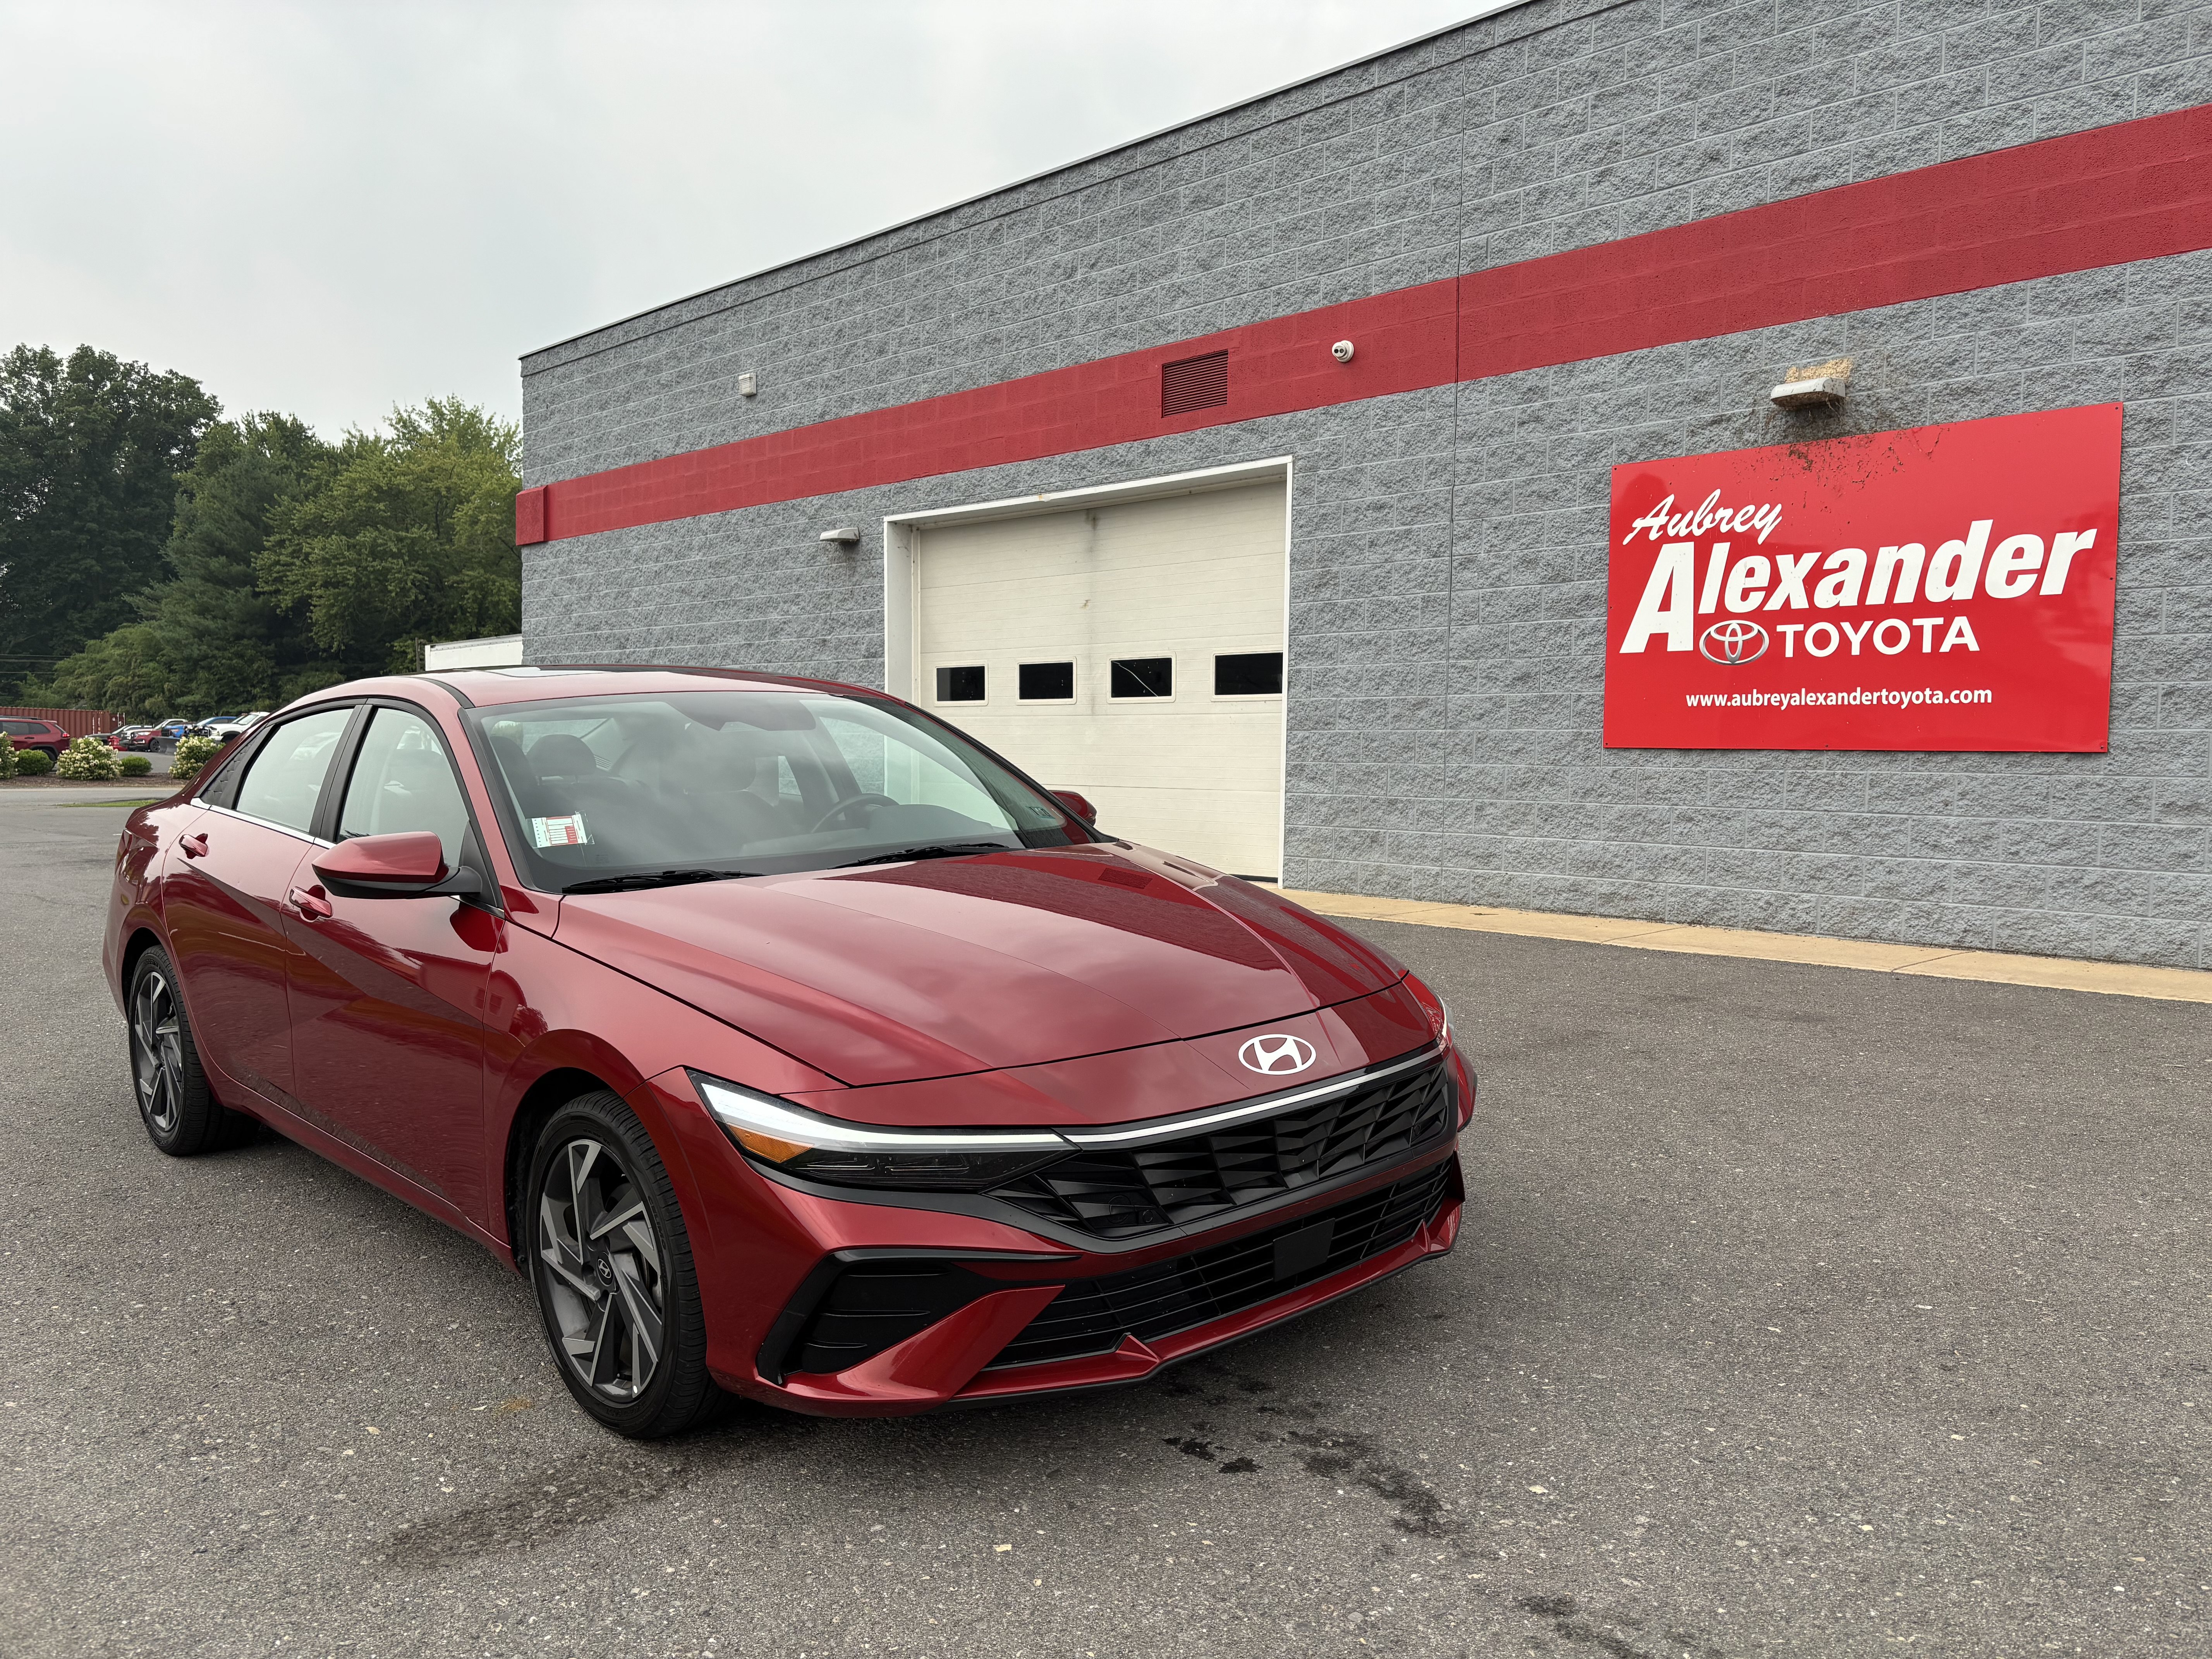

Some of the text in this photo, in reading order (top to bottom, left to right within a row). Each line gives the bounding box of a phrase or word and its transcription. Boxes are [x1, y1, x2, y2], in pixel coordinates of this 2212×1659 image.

[1622, 488, 1782, 545] Aubrey
[1619, 519, 2097, 654] Alexander
[1776, 616, 1980, 658] TOYOTA
[1686, 687, 1992, 711] www.aubreyalexandertoyota.com
